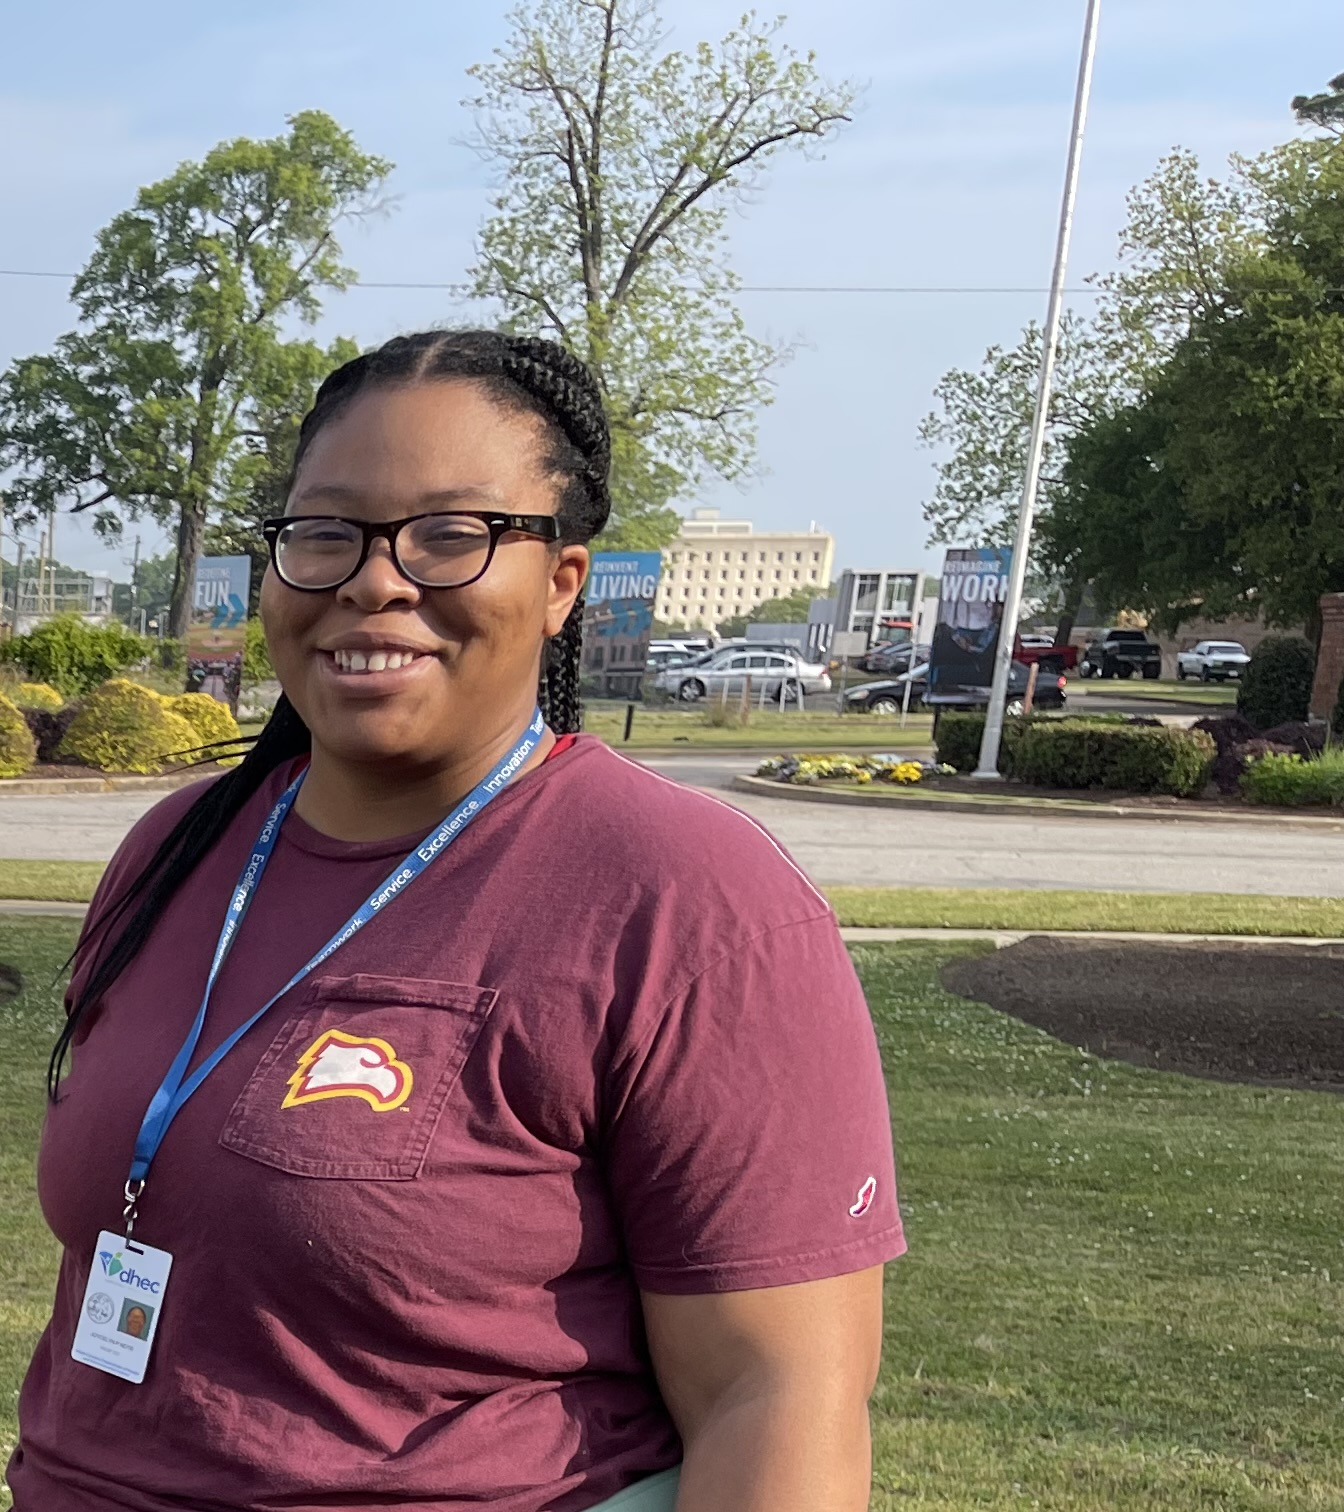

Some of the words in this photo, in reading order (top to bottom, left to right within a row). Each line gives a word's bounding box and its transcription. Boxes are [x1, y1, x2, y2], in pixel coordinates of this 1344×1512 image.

[195, 581, 231, 607] FUN
[588, 575, 656, 599] LIVING
[119, 1267, 161, 1295] dhec
